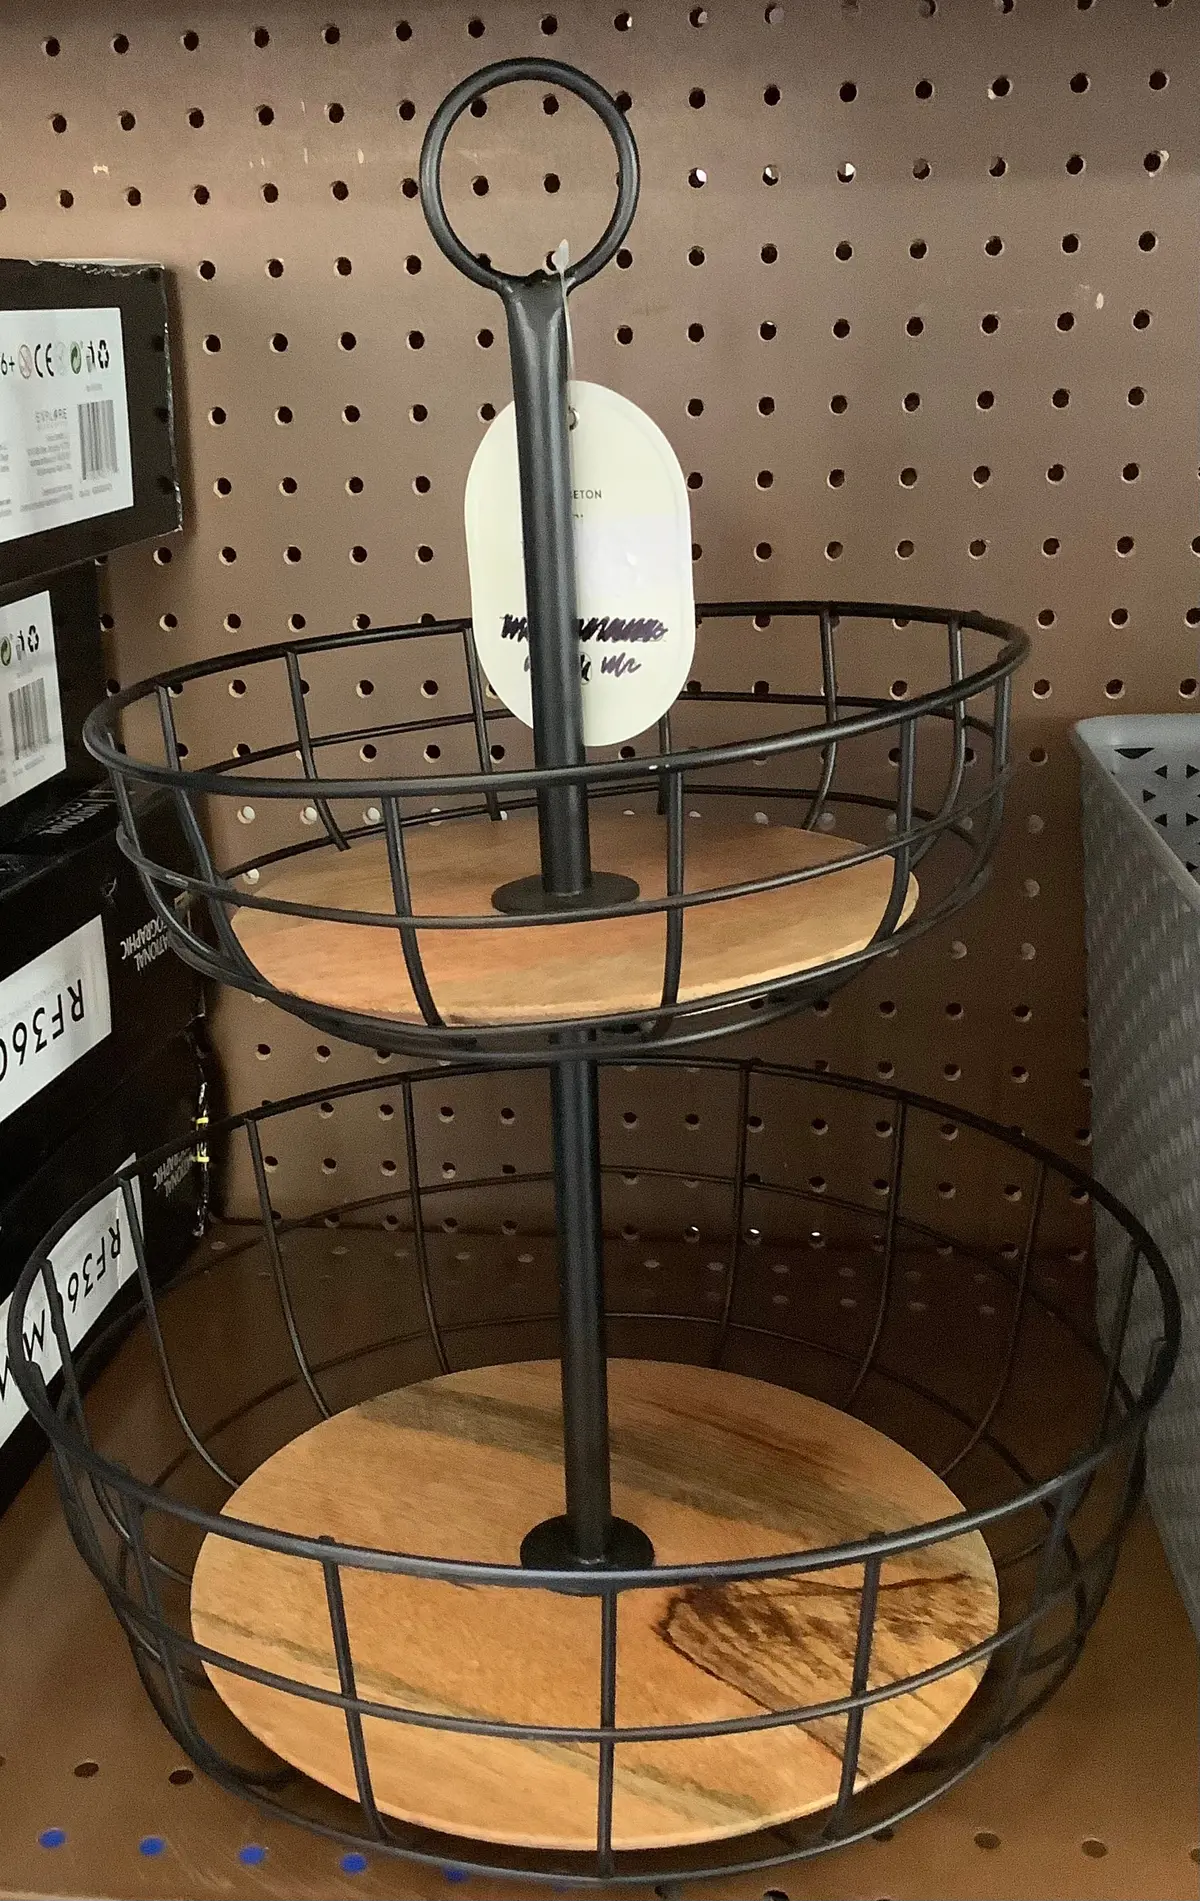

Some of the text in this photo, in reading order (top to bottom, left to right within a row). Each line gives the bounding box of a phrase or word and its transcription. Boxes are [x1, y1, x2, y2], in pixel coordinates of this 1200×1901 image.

[34, 343, 54, 378] CE
[571, 489, 602, 500] ETON
[120, 916, 167, 961] OGRAPHIC
[134, 935, 168, 971] ATIONAL
[67, 1218, 121, 1314] RF36
